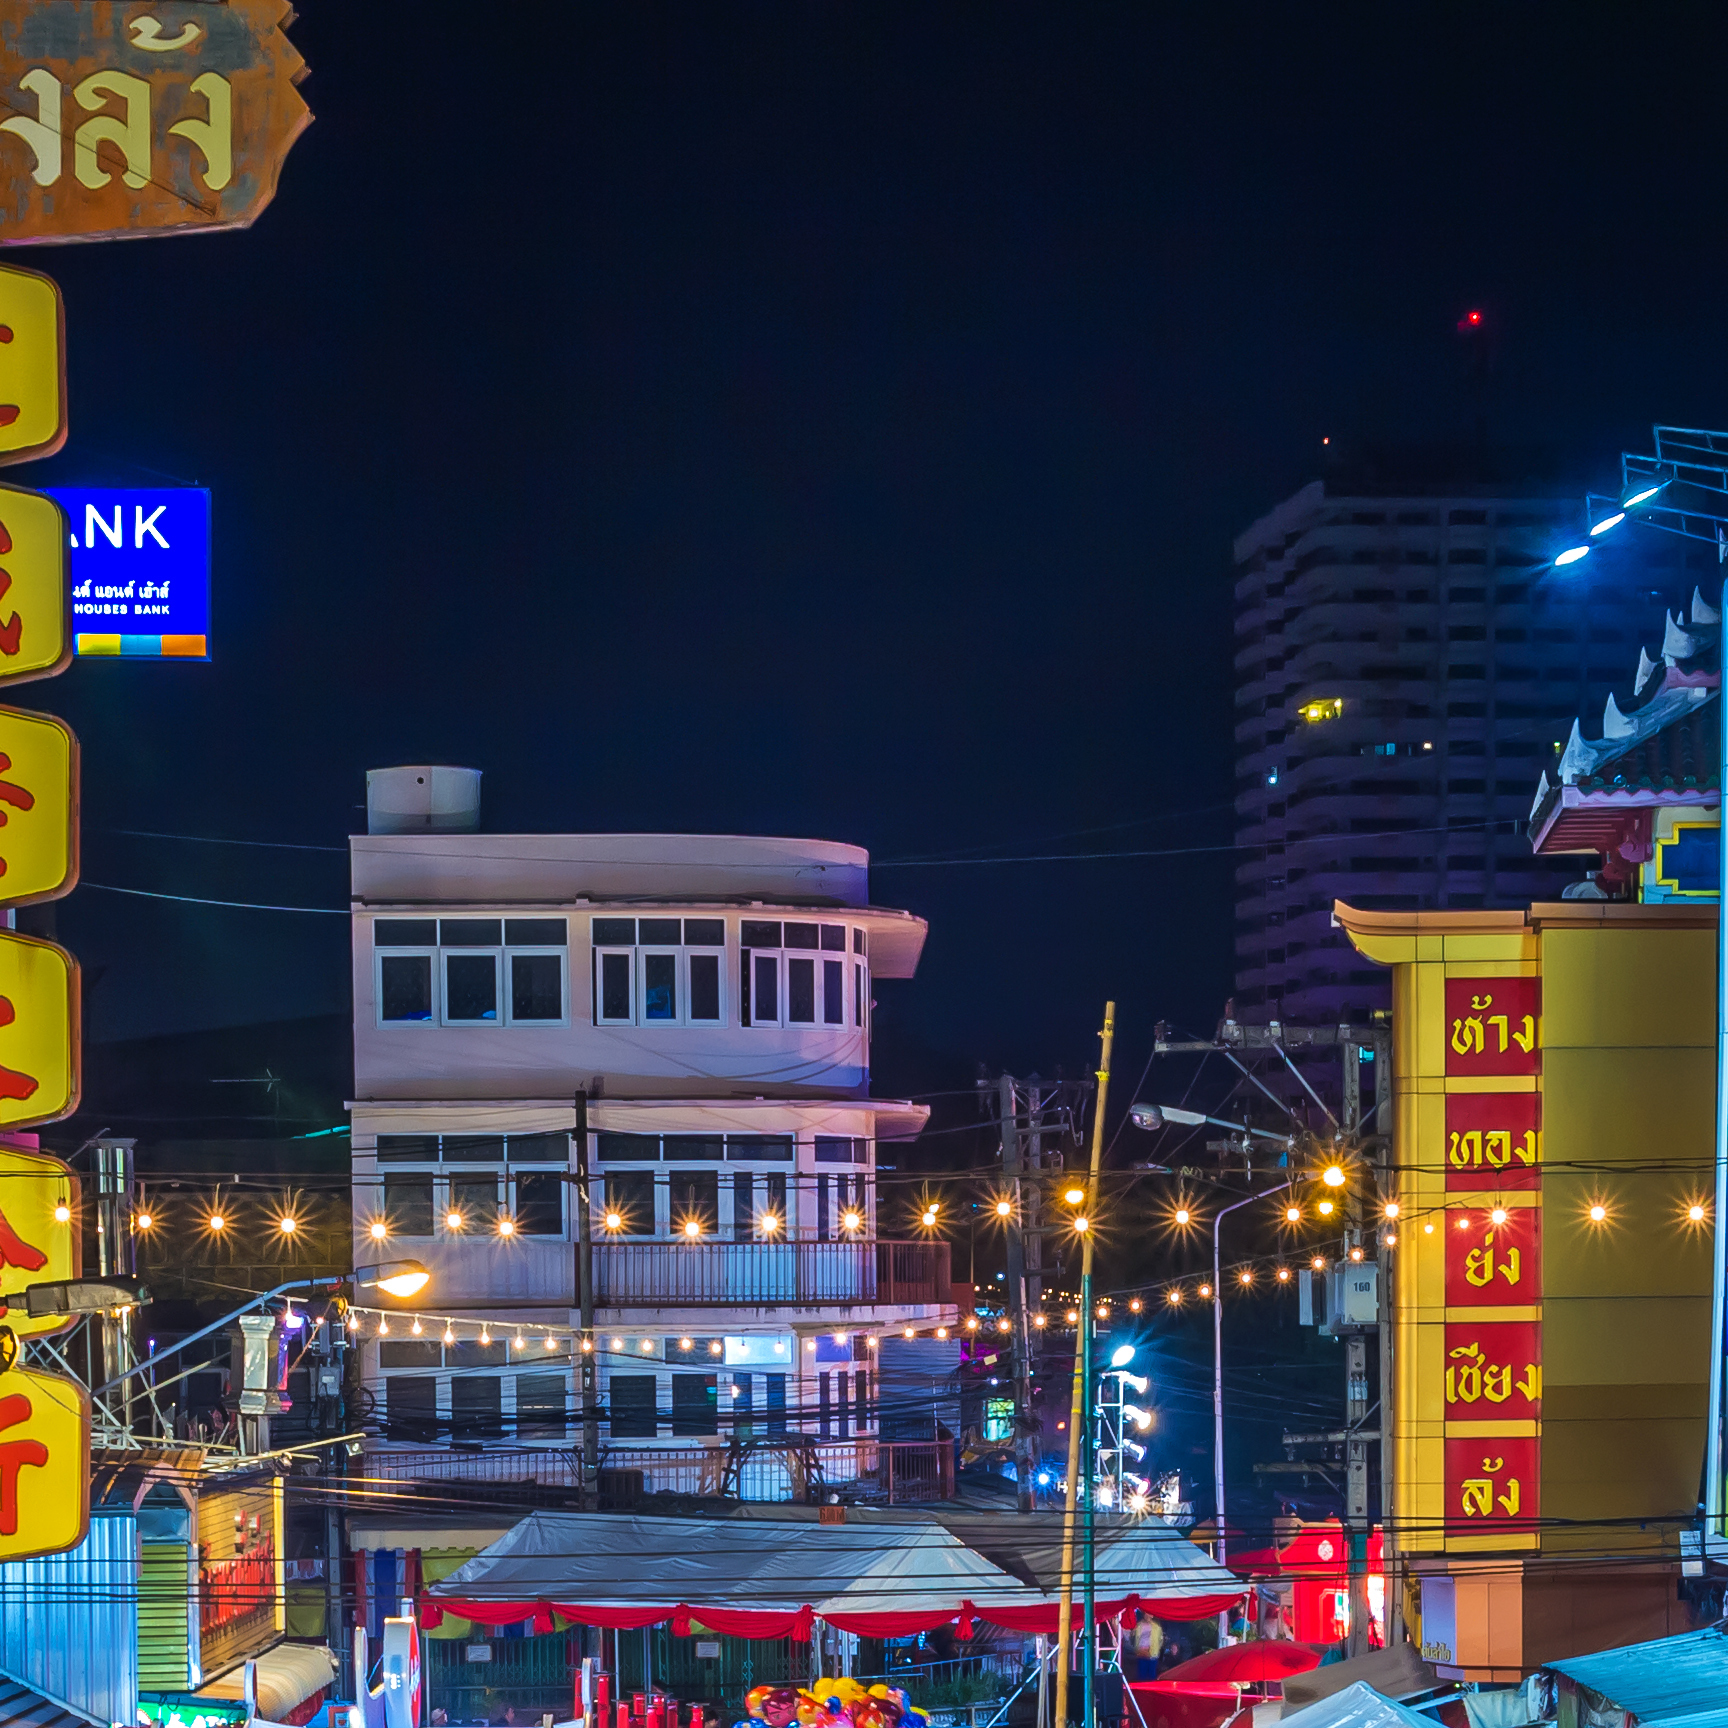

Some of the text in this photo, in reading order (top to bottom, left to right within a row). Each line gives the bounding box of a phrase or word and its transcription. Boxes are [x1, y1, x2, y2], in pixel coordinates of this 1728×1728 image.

[71, 503, 170, 548] NK
[74, 604, 170, 615] HOUSES BANK
[1449, 1129, 1541, 1169] ทอง
[1353, 1281, 1371, 1292] 160
